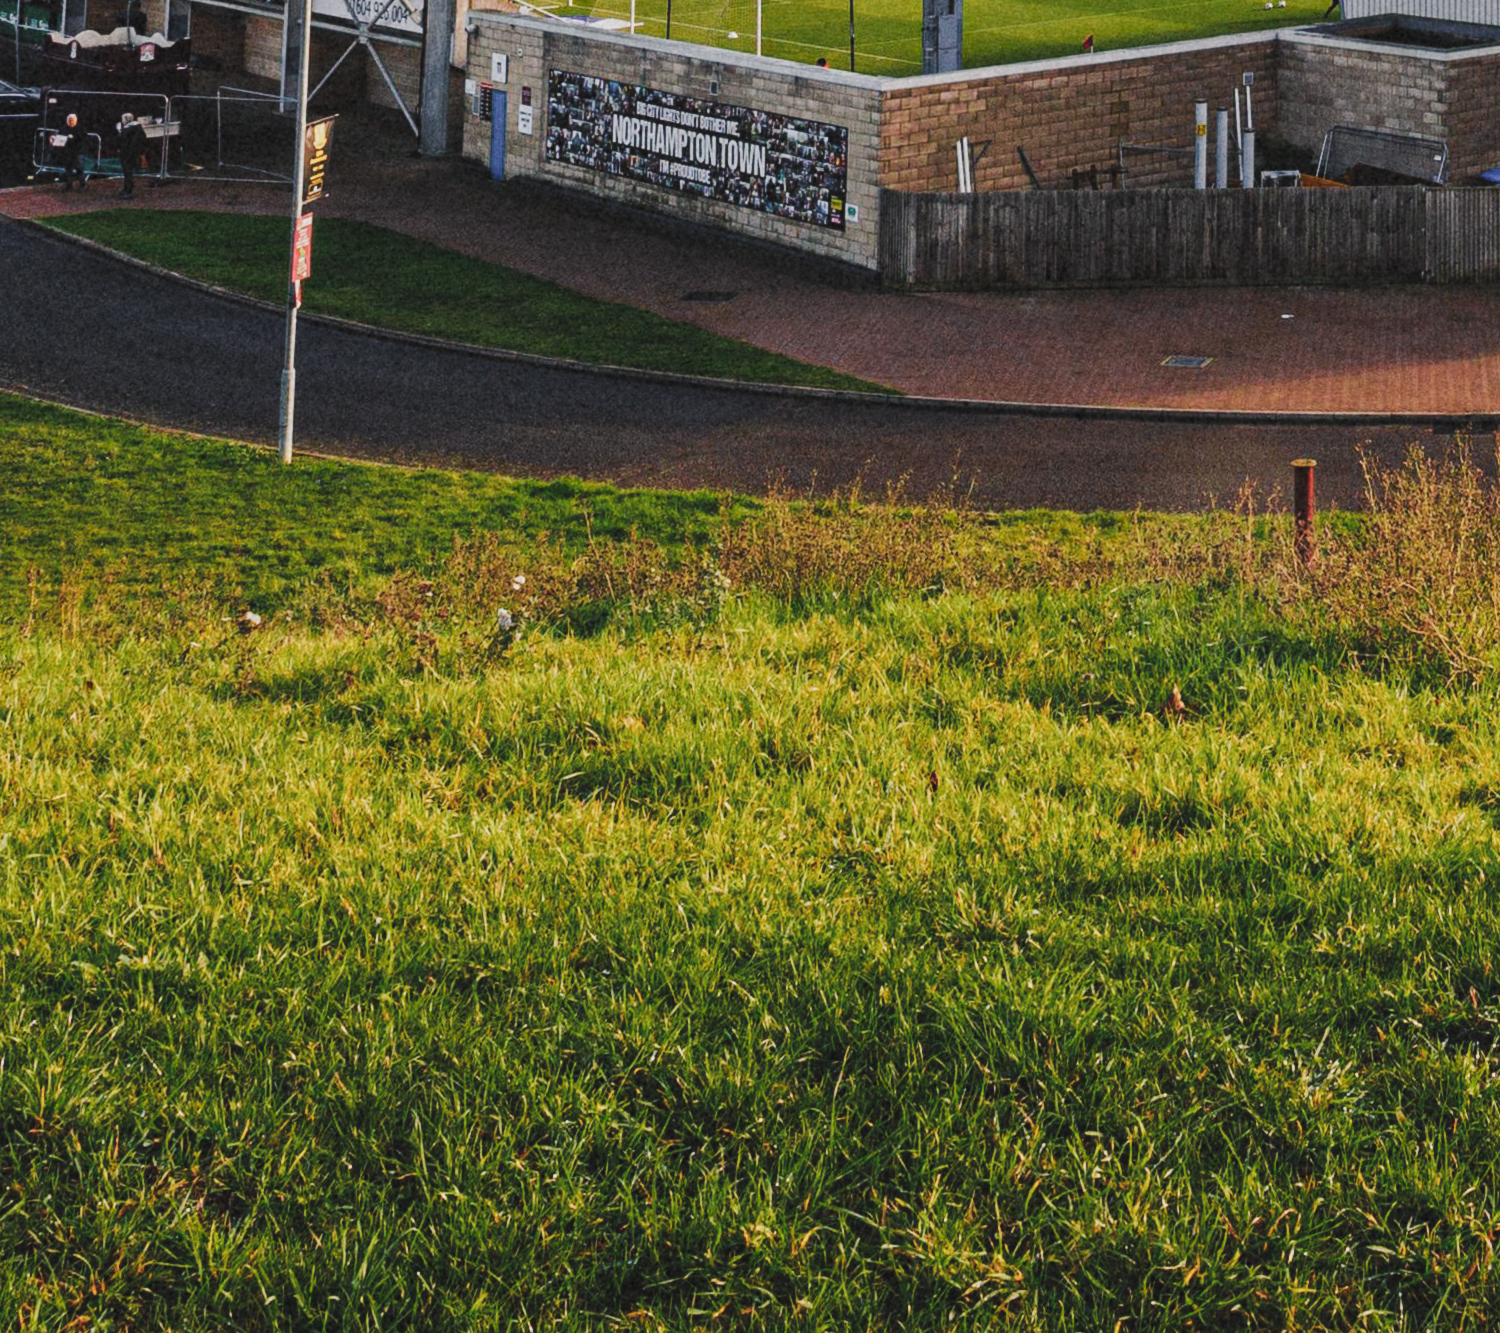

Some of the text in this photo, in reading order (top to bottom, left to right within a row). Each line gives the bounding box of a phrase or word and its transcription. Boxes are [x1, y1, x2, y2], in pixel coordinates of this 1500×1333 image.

[391, 5, 409, 24] 004
[647, 102, 660, 119] CITY
[659, 106, 680, 124] LIGHTS
[681, 110, 699, 128] DON'T
[612, 114, 766, 178] NORTHAMPTON TOWN
[659, 159, 711, 185] I'M #PROUDTOBE
